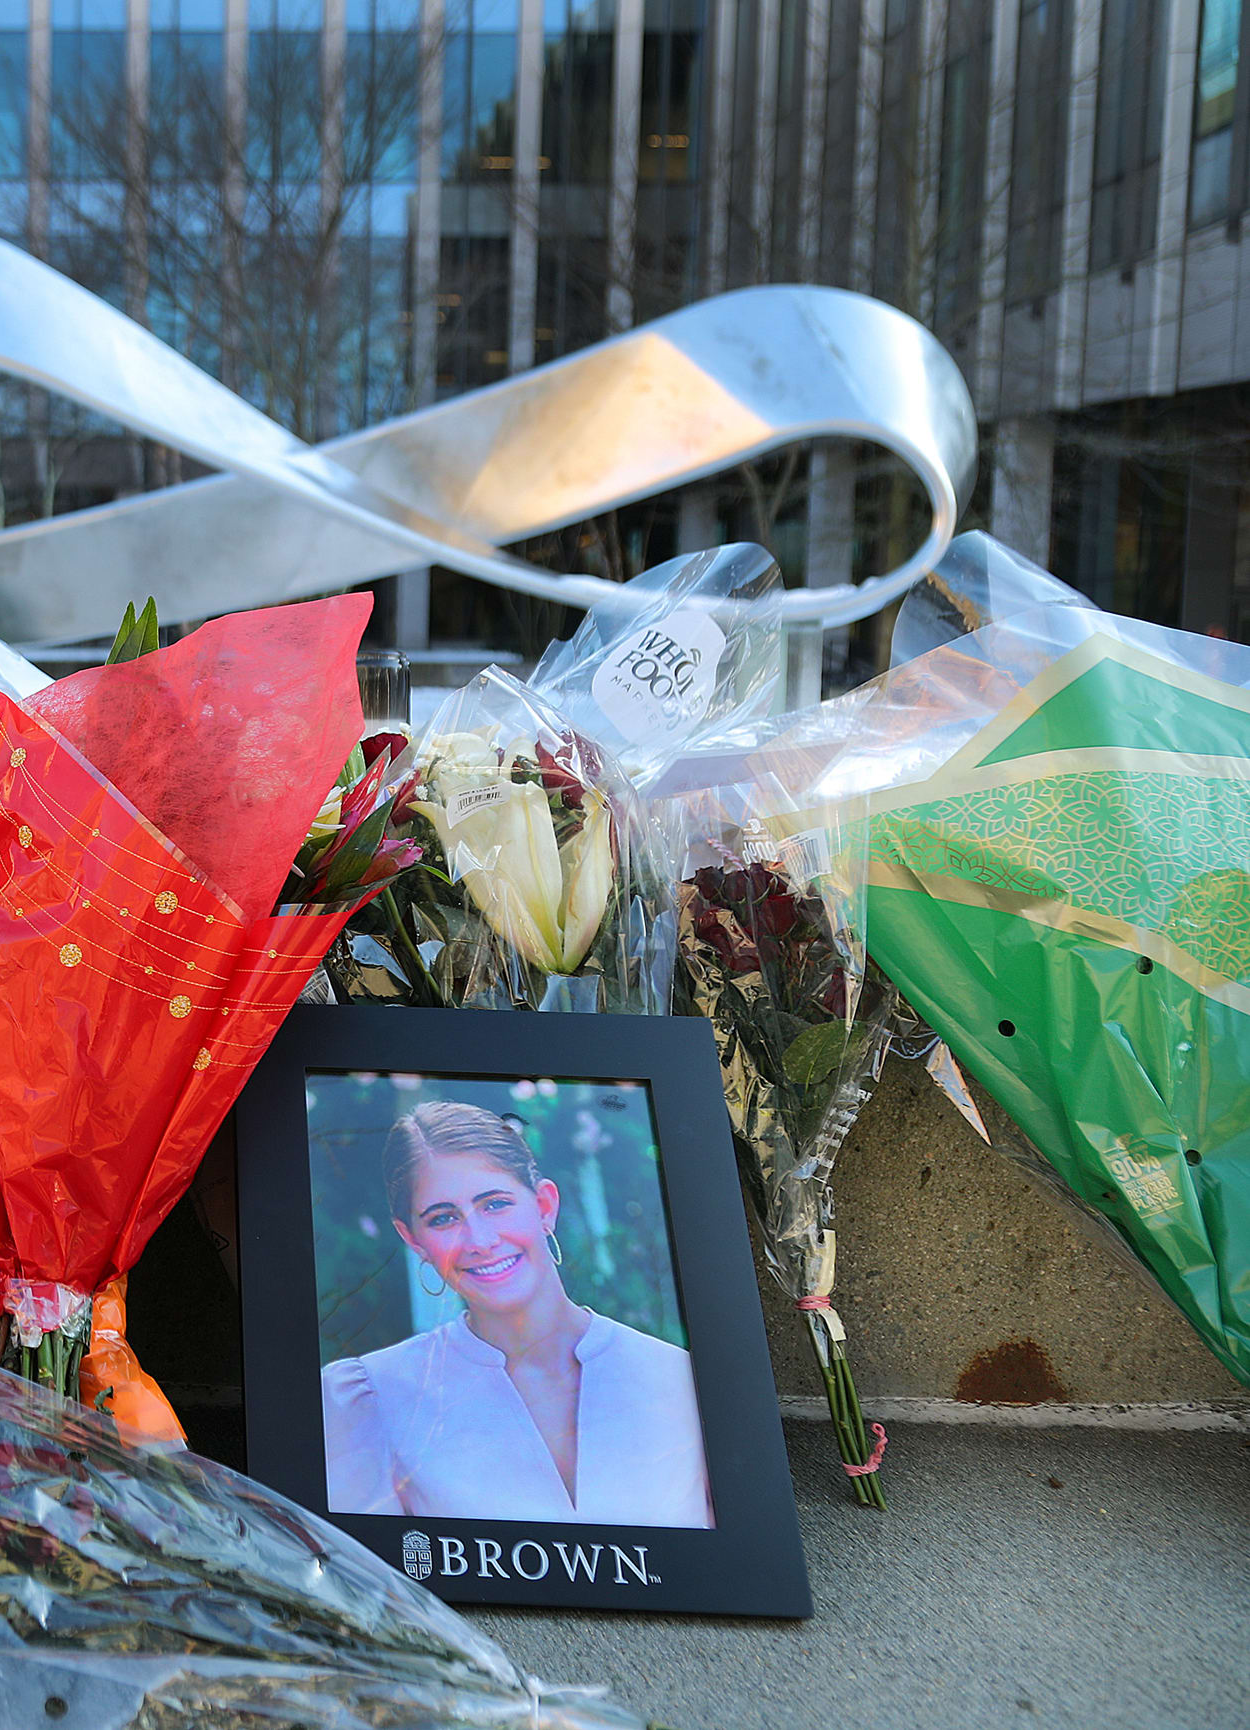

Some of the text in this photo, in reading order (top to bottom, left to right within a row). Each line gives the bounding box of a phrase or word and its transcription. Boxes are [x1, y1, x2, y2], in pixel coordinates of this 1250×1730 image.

[1110, 1151, 1161, 1182] 90%
[1126, 1176, 1172, 1201] RECYCLED
[1132, 1187, 1179, 1211] PLASTIC
[437, 1535, 649, 1586] BROWN
